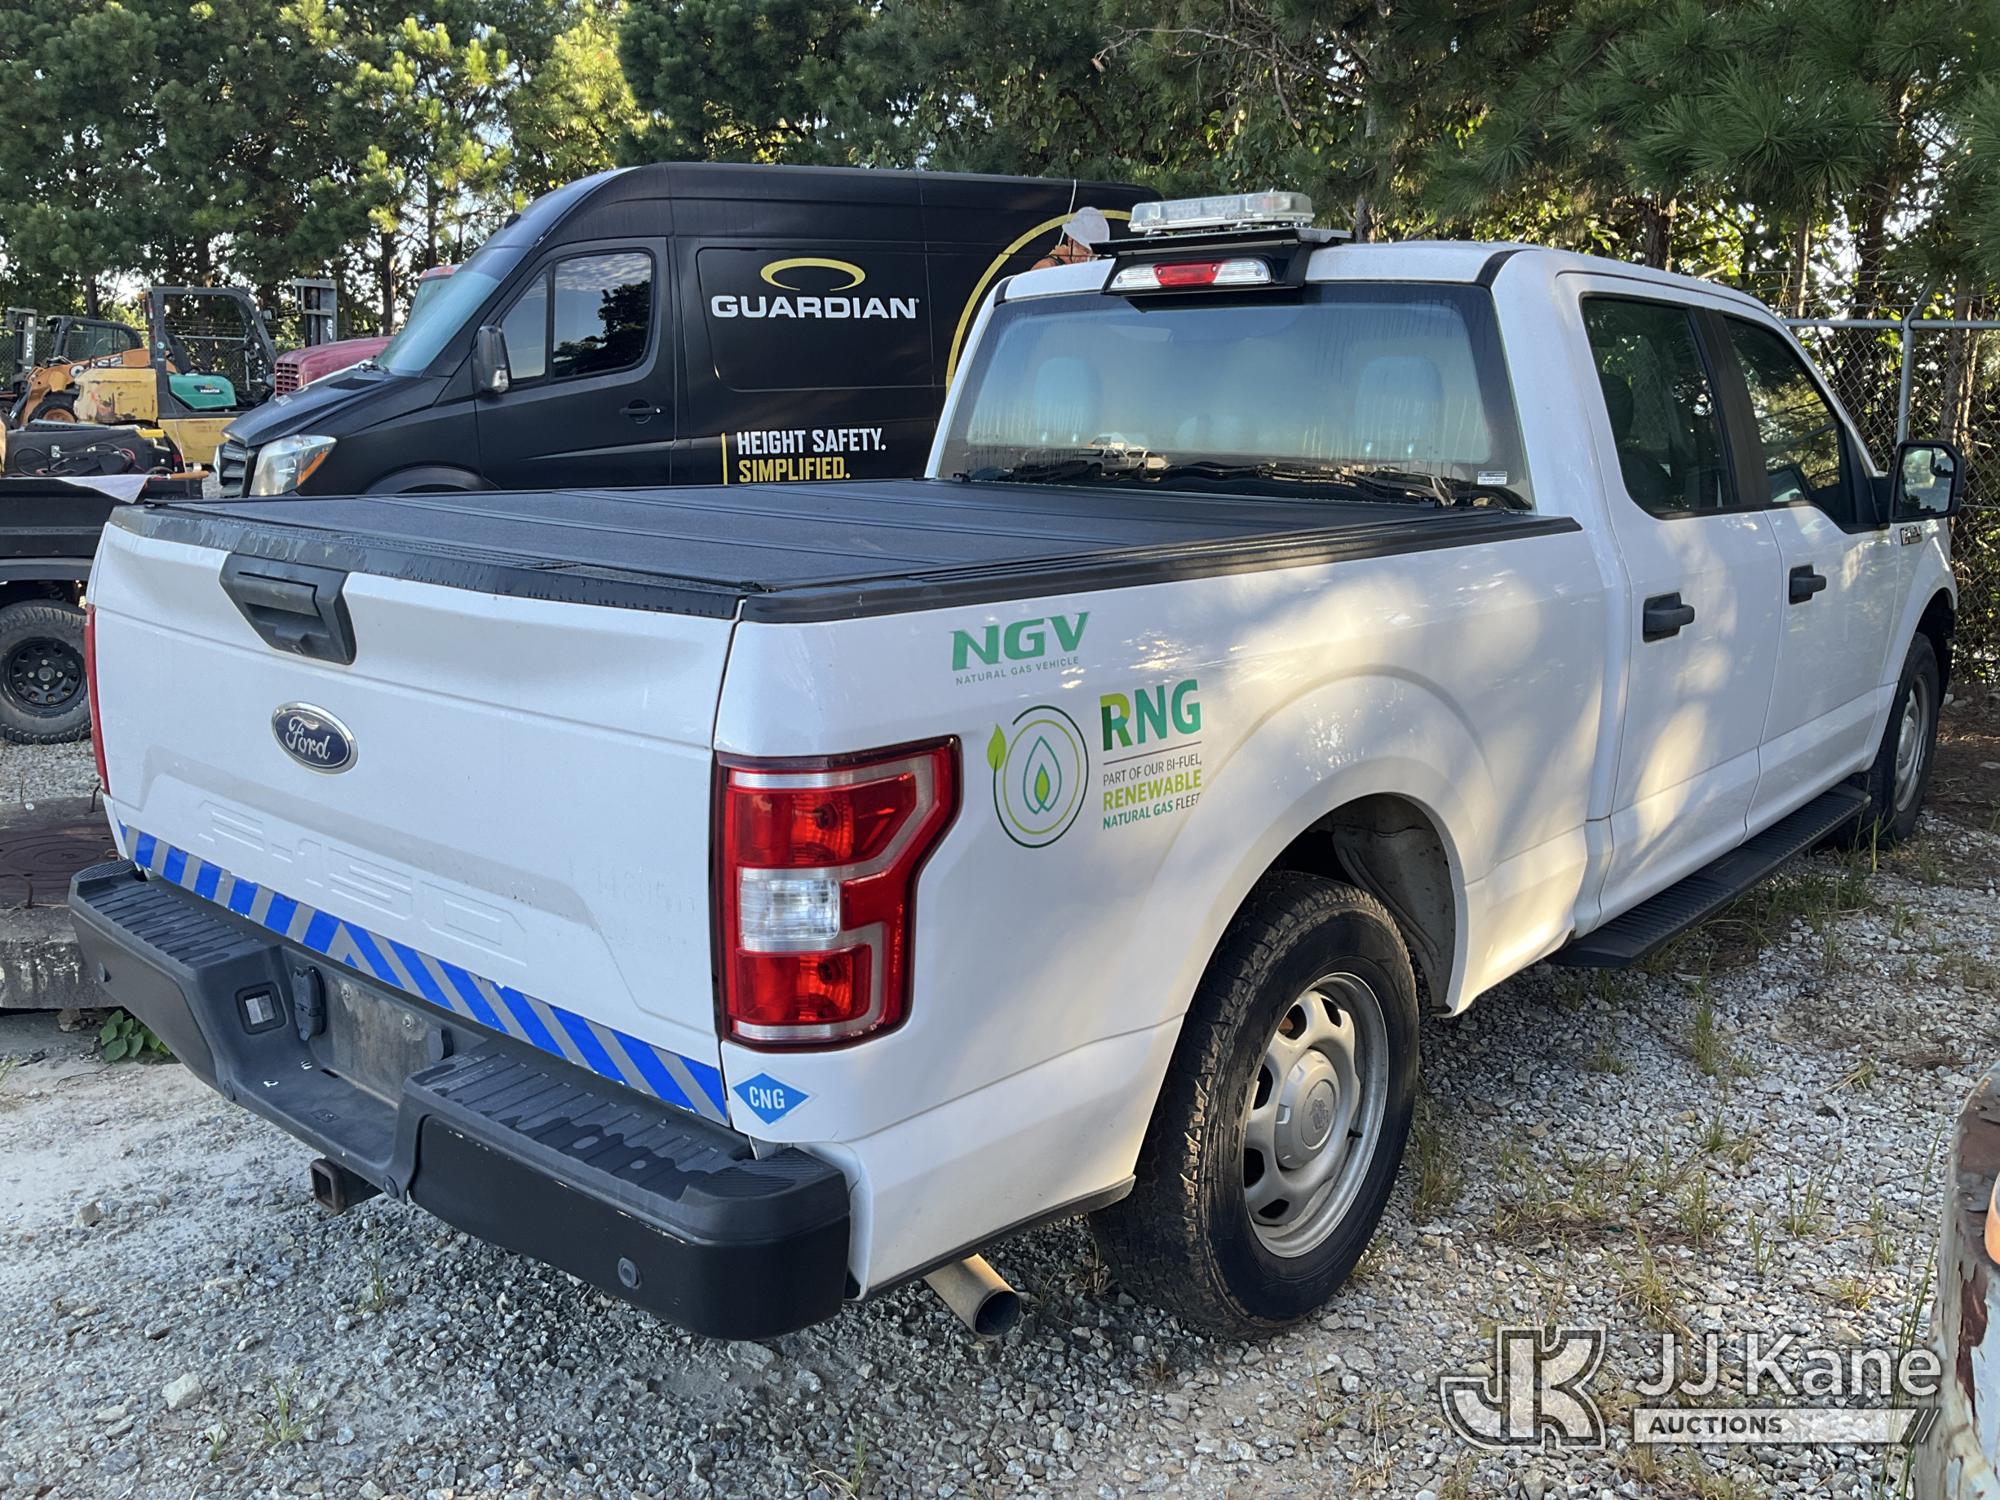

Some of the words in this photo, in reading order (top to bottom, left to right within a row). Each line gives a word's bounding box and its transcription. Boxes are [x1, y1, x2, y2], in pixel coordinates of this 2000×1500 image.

[711, 295, 917, 319] GUARDIAN
[736, 430, 806, 455] HEIGHT
[812, 427, 886, 453] SAFETY.
[738, 456, 851, 482] SIMPLIFIED.
[949, 611, 1091, 672] NGV
[955, 668, 1006, 687] NATURAL
[1010, 664, 1033, 676] GAS
[1035, 656, 1080, 672] VEHICLE
[1100, 678, 1201, 752] RNG
[285, 716, 331, 760] Ford
[1103, 769, 1126, 787] PART
[1128, 766, 1143, 780] OF
[1144, 761, 1164, 777] OUR
[1103, 768, 1202, 812] RENEWABLE
[1103, 806, 1151, 831] NATURAL
[1153, 799, 1174, 817] GAS
[1175, 792, 1201, 811] FLEET
[749, 1085, 786, 1110] CNG
